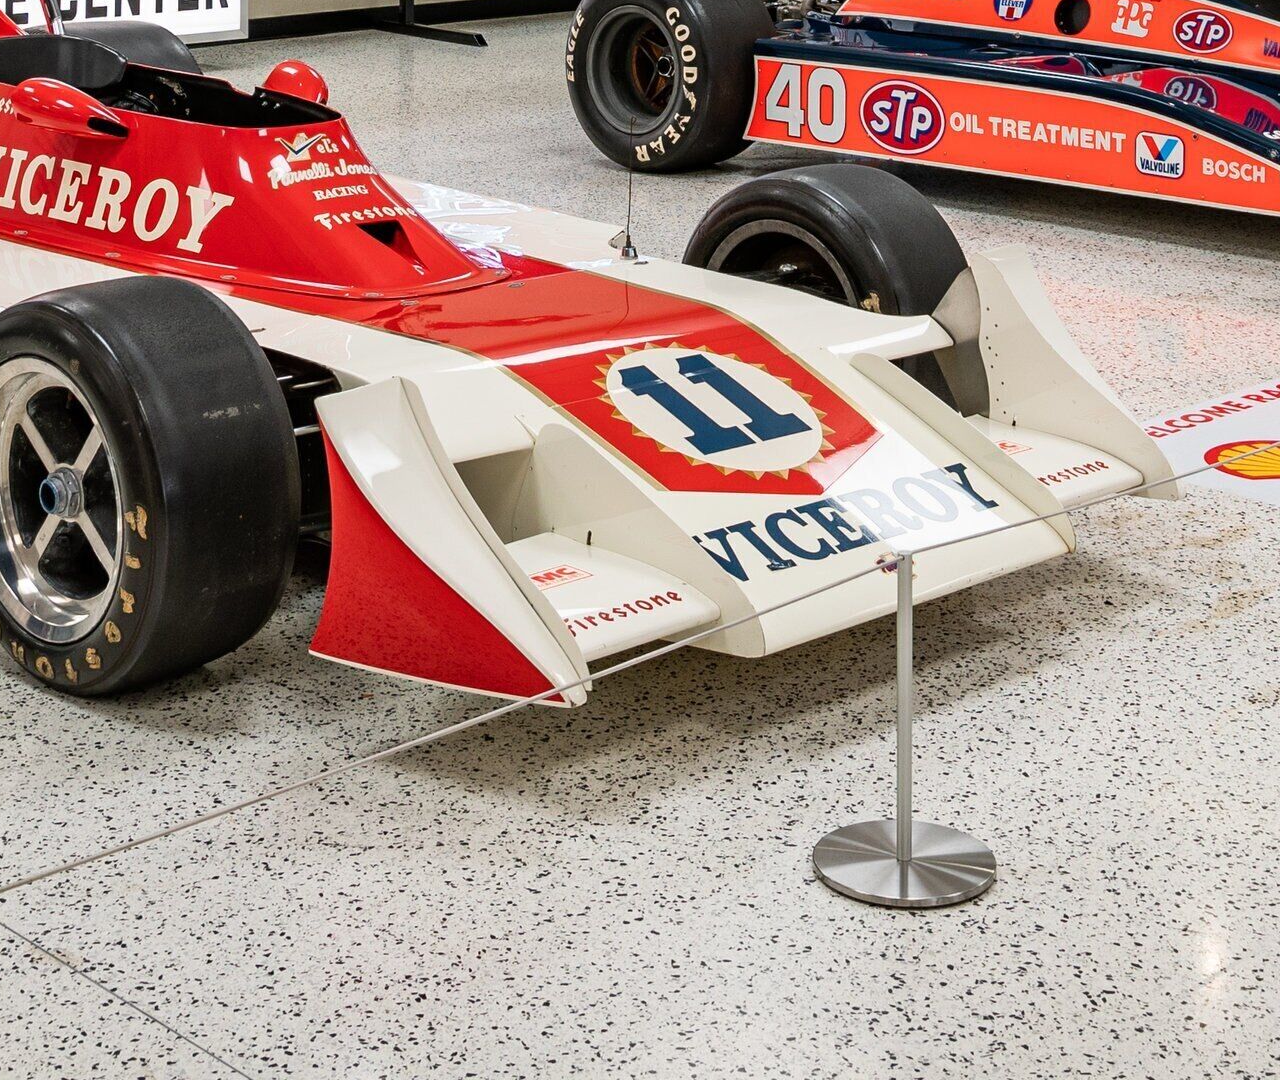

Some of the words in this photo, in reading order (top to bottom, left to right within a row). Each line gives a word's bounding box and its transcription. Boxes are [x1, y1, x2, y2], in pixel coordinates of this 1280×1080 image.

[1000, 0, 1026, 9] ELEVEN
[567, 9, 585, 83] EAGLE
[666, 6, 699, 85] GOOD
[1178, 12, 1226, 49] STP
[766, 63, 847, 144] 40
[870, 88, 933, 143] STP
[950, 111, 984, 135] OIL
[988, 116, 1126, 153] TREATMENT
[635, 112, 692, 163] YEAR
[268, 162, 334, 189] Parnelli
[1140, 156, 1181, 177] VALVOLINE
[1202, 157, 1267, 184] BOSCH
[313, 184, 368, 201] RACING
[314, 207, 417, 230] Firestone
[618, 352, 818, 457] 11
[1149, 399, 1247, 439] ELCOME
[693, 462, 1001, 583] VICEROY
